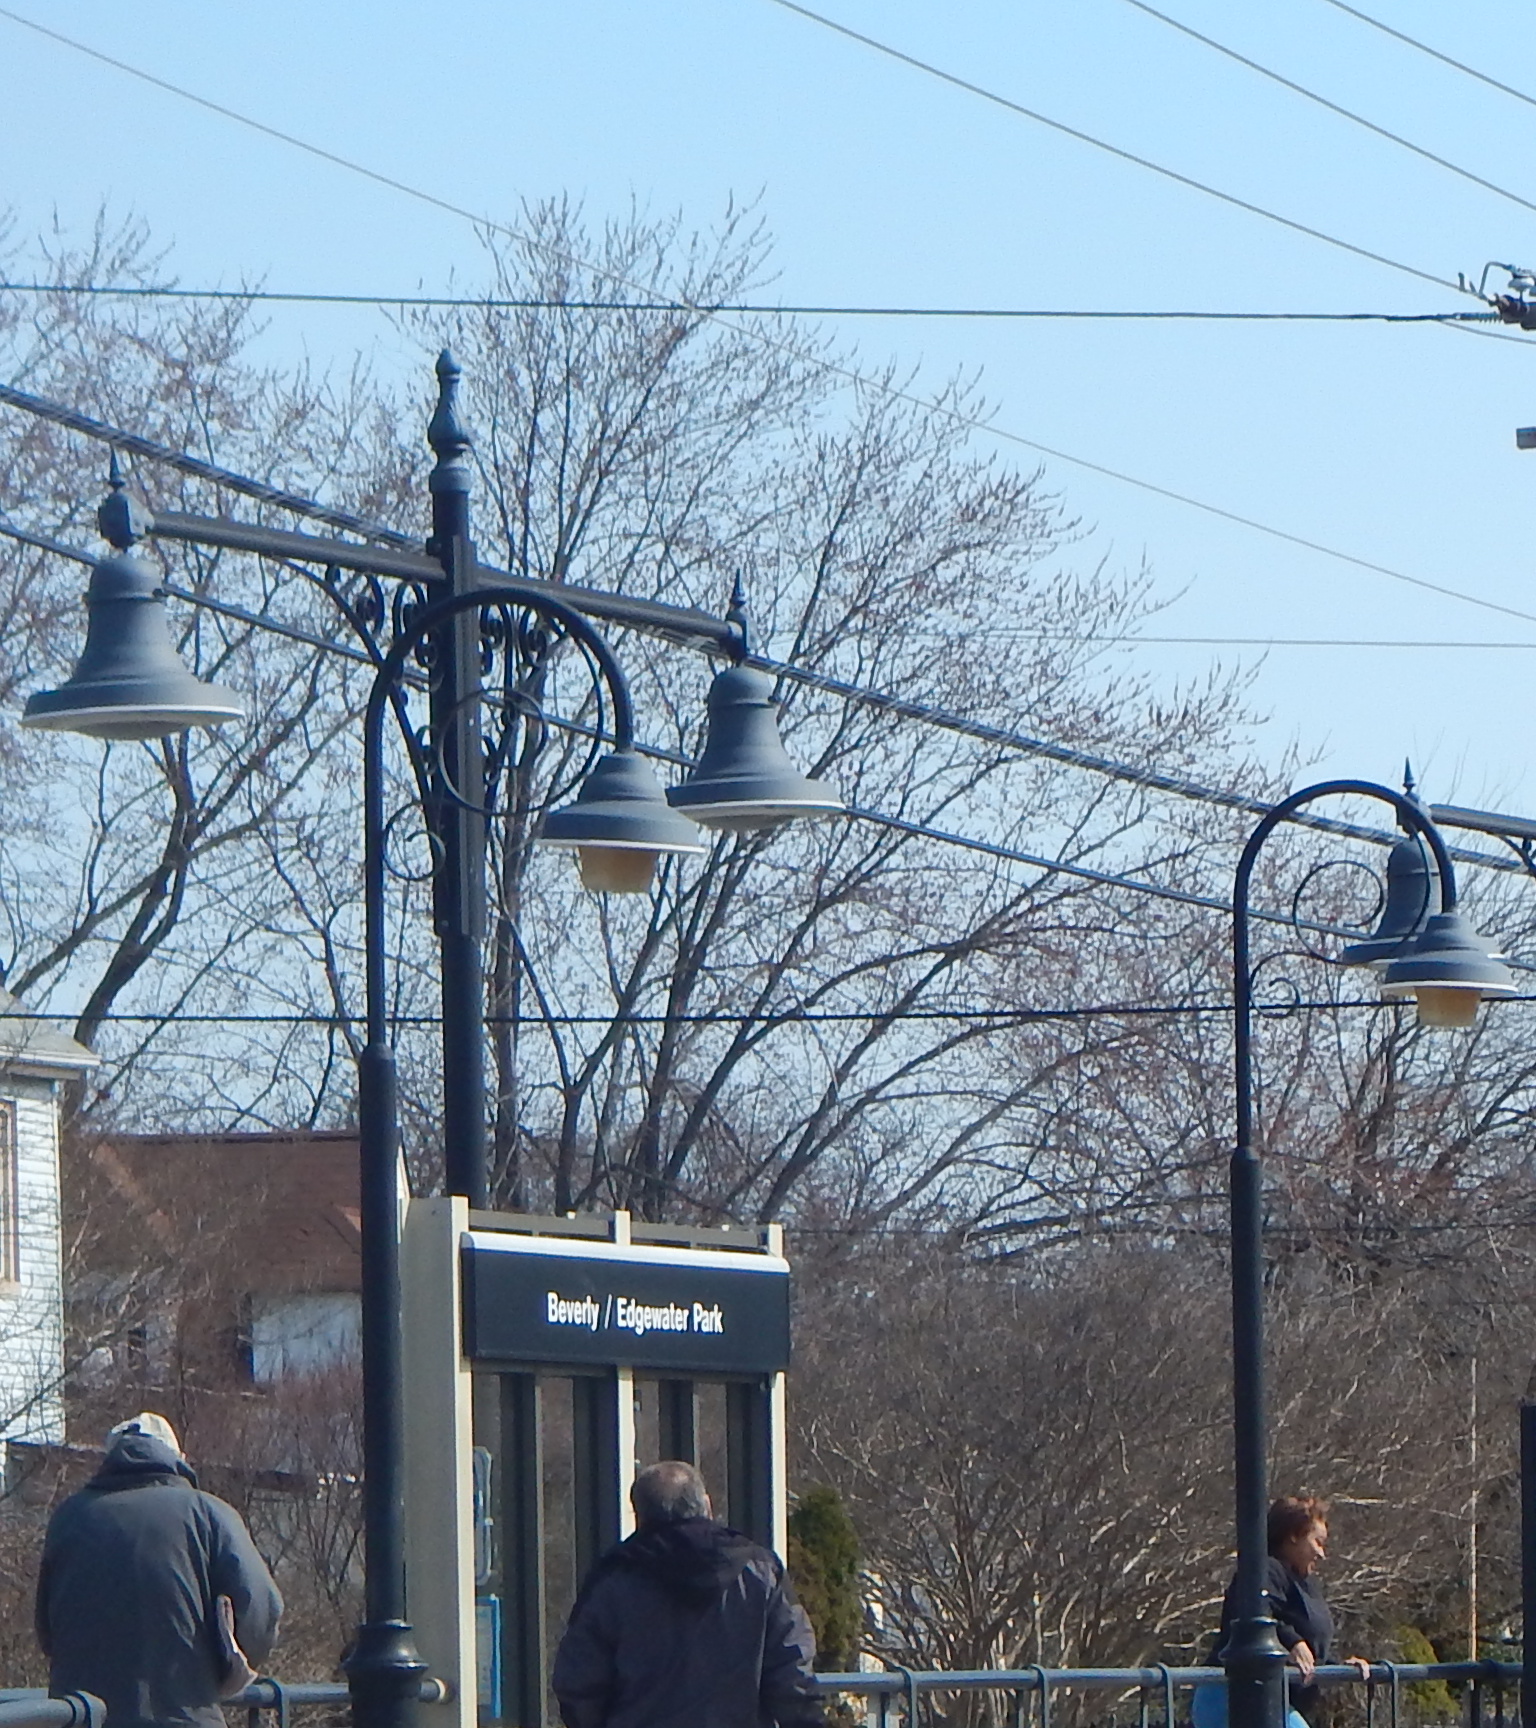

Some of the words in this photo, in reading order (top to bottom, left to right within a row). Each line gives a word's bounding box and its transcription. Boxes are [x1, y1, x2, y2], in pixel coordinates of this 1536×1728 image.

[547, 1291, 600, 1332] Beverly
[617, 1296, 690, 1335] Edgewater
[693, 1301, 724, 1334] Park
